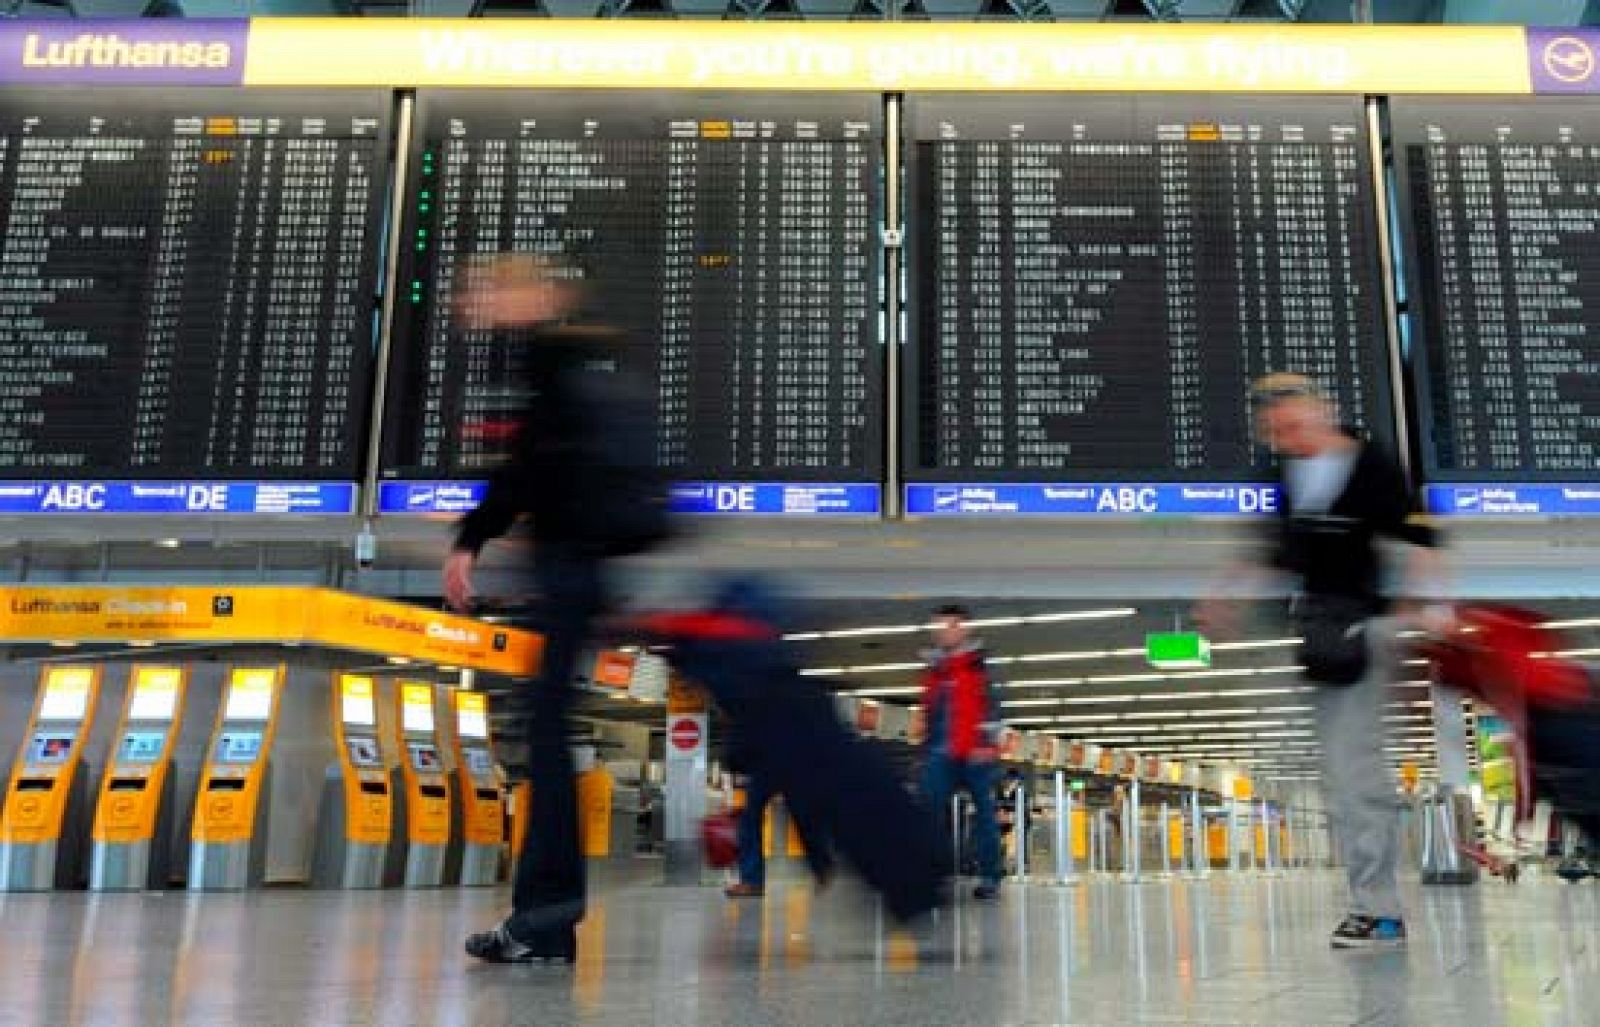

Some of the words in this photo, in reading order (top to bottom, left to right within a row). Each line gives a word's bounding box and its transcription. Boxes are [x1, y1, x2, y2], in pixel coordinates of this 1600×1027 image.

[22, 33, 231, 68] Lufthansa
[419, 30, 667, 73] Wherever
[689, 36, 852, 80] you're
[1051, 36, 1187, 77] we're
[42, 485, 106, 510] ABC
[187, 485, 227, 510] DE
[717, 486, 755, 511] DE
[1097, 488, 1158, 512] ABC
[1239, 488, 1278, 512] DE
[11, 598, 100, 614] Lufthansa
